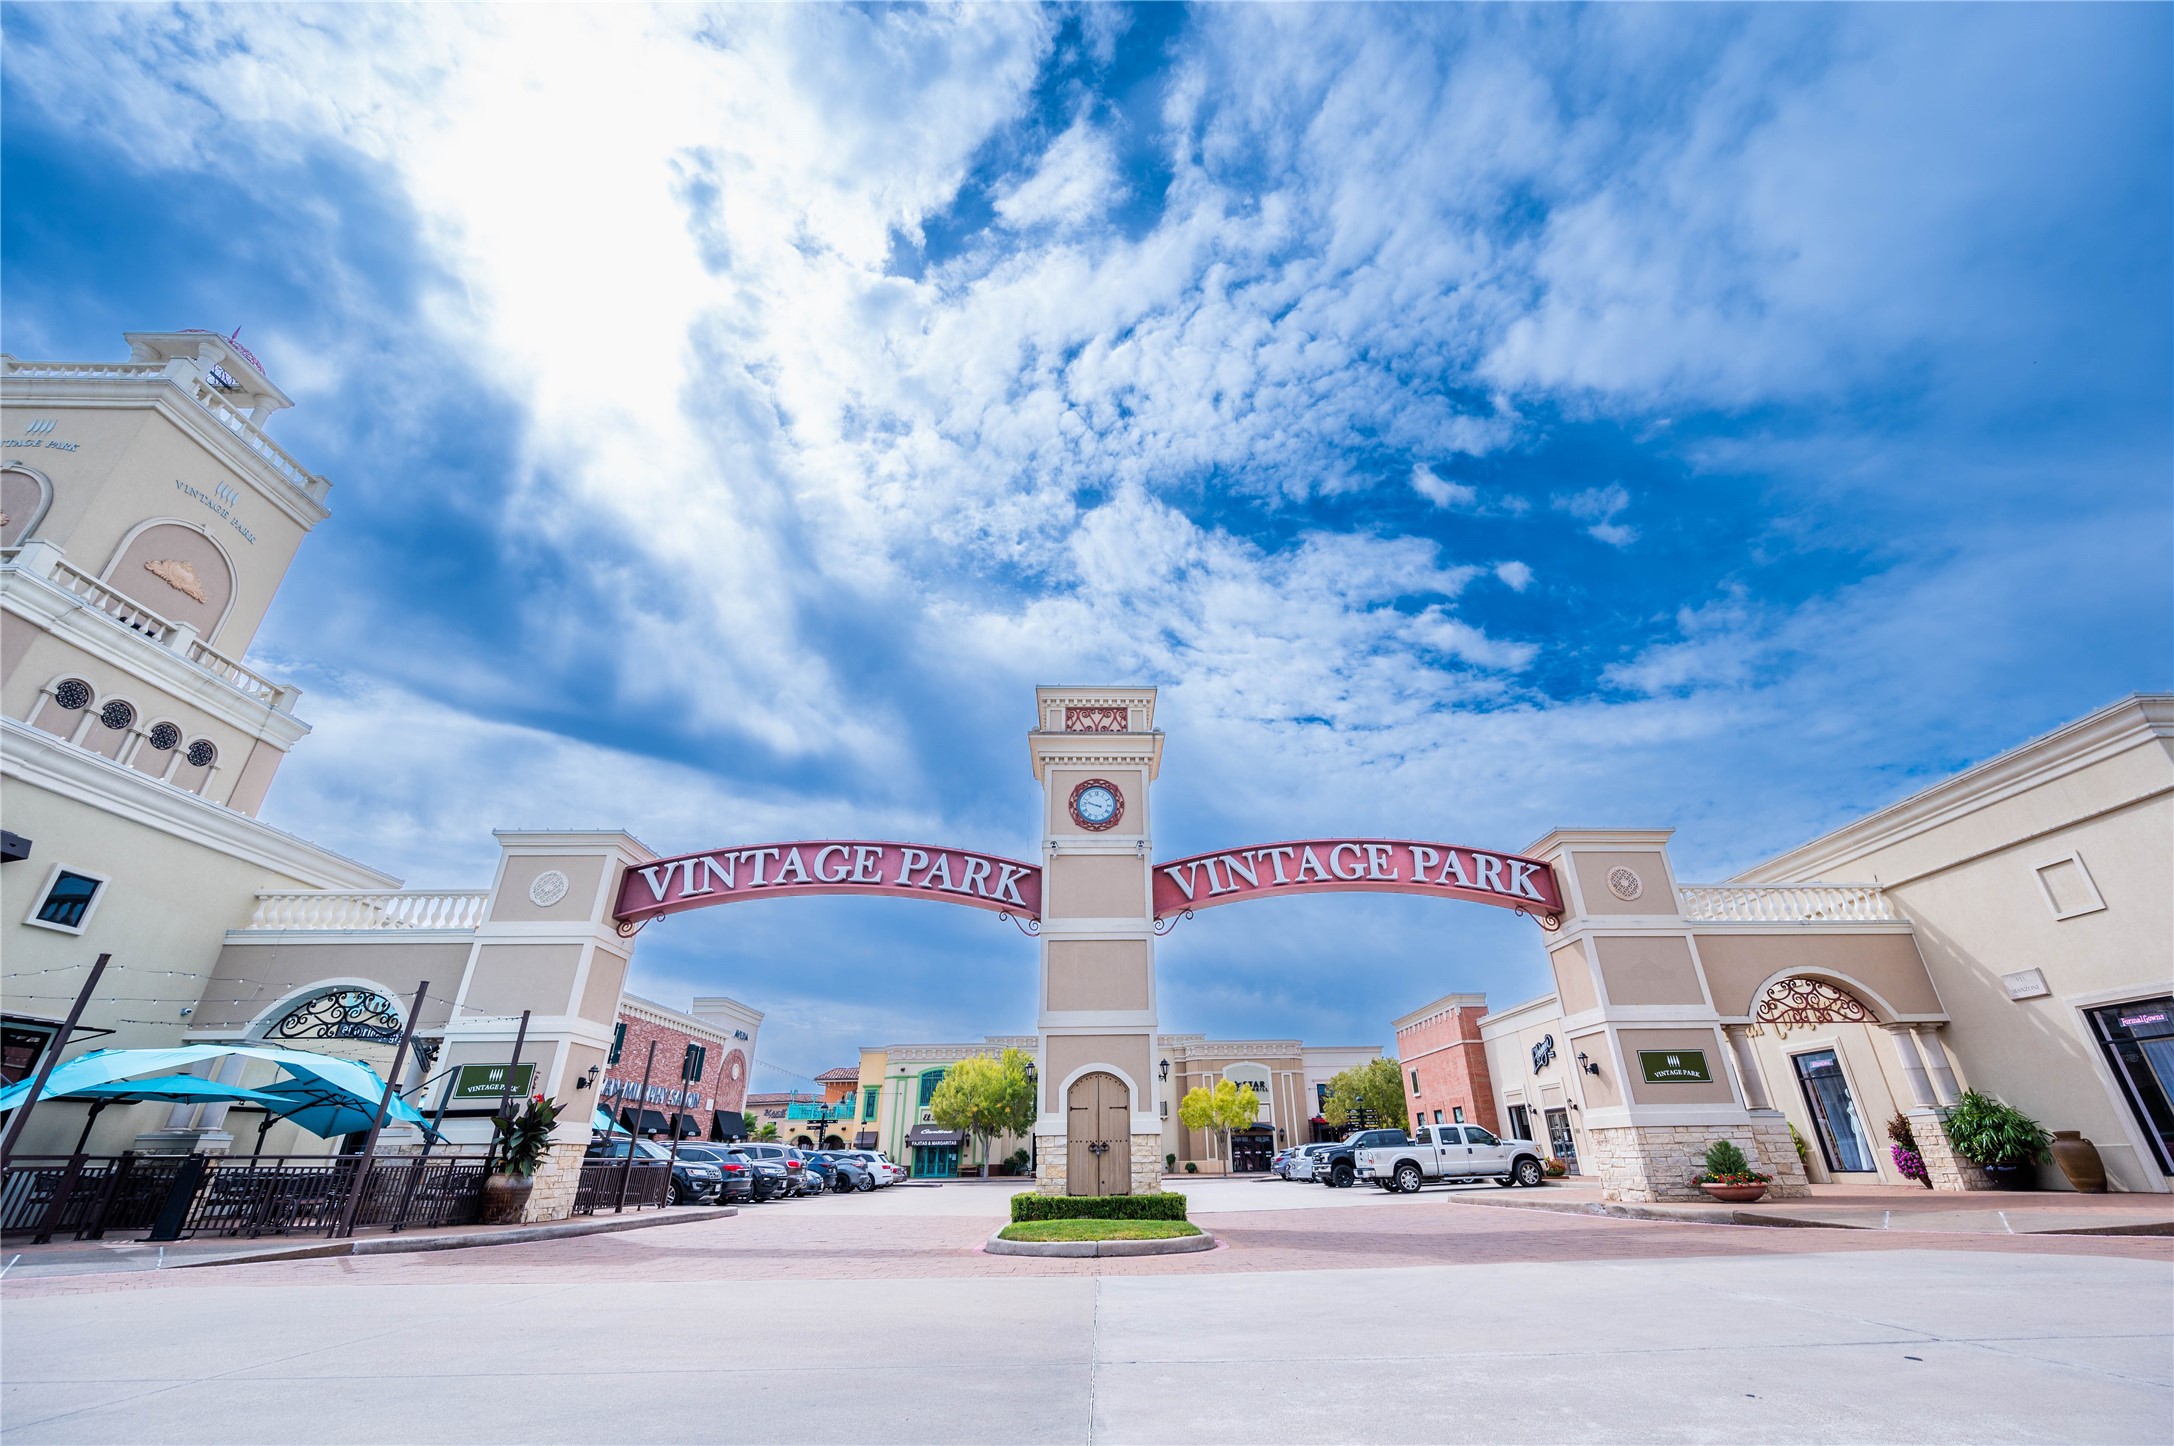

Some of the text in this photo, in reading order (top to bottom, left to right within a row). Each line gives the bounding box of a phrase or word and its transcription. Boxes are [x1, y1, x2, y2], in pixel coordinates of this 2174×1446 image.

[45, 440, 80, 453] PARK
[175, 479, 257, 545] VINTAGE PARK
[638, 845, 1031, 907] VINTAGE PARK
[1164, 843, 1546, 901] VINTAGE PARK
[1654, 1069, 1701, 1078] VINTAGE PARK
[467, 1083, 520, 1093] VINTAGE PK
[667, 1088, 701, 1109] SAON
